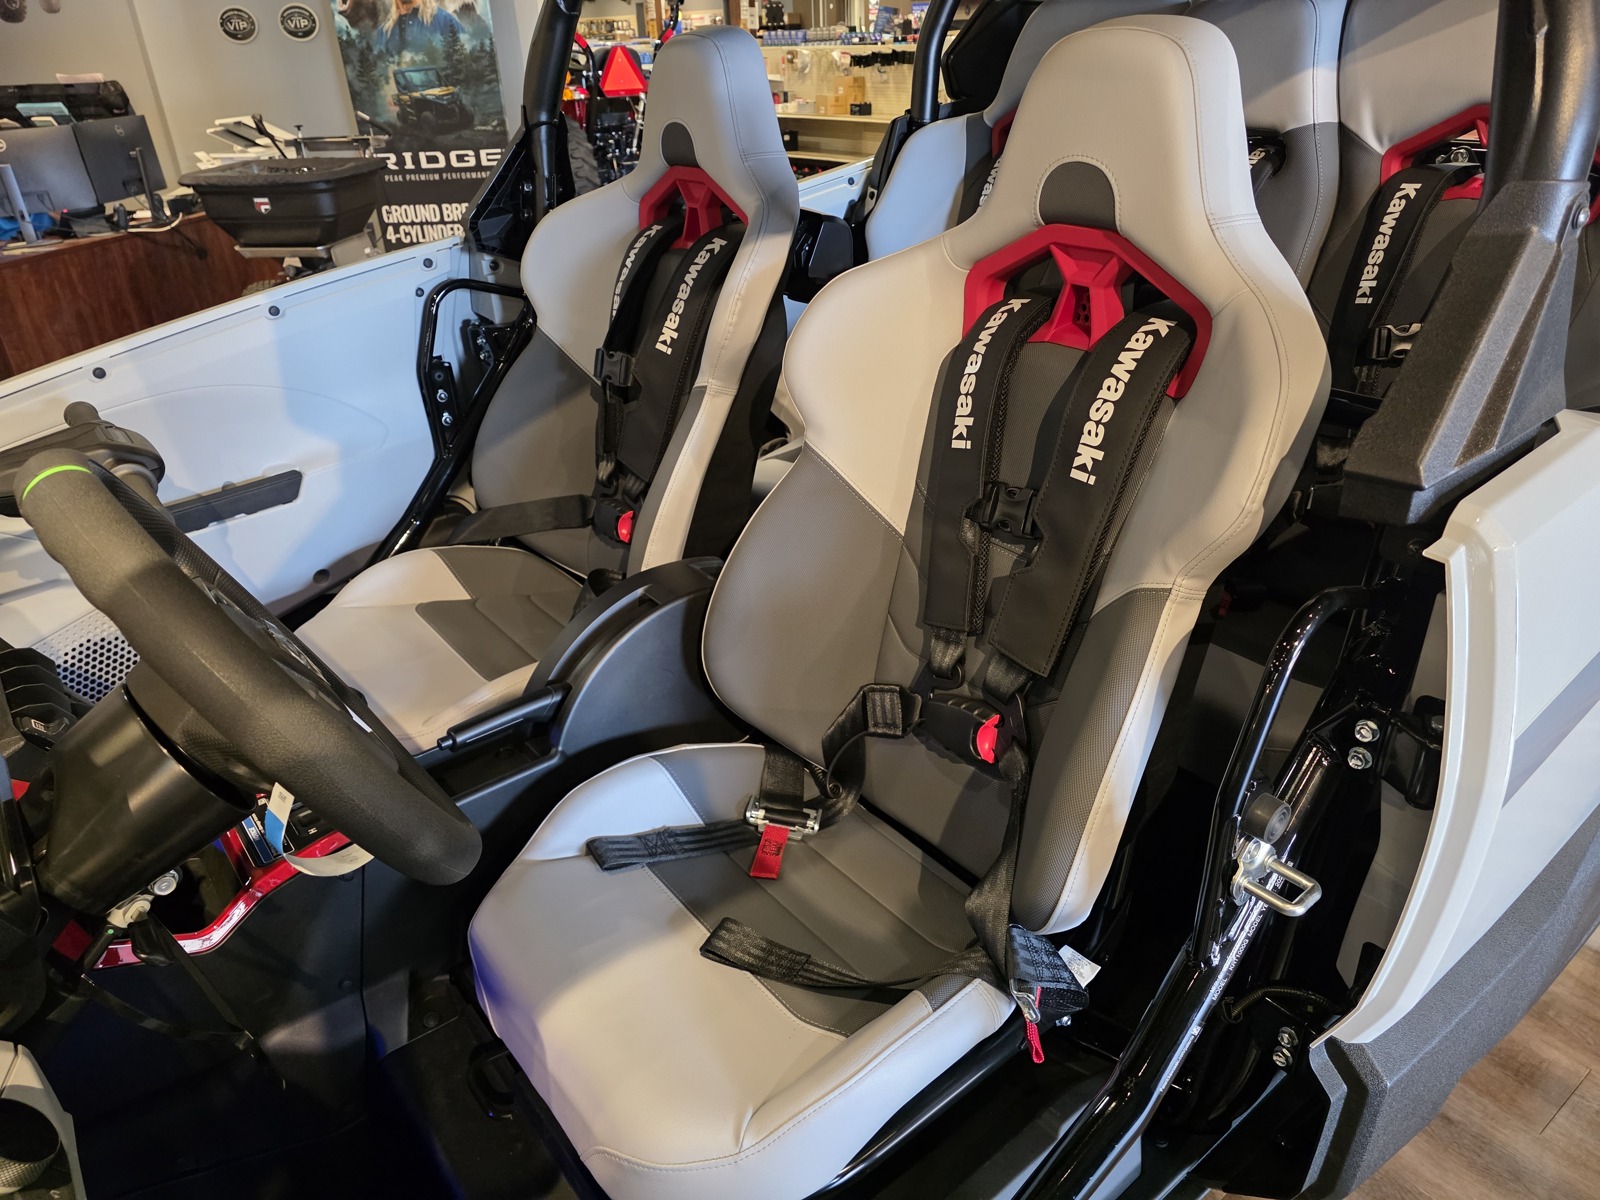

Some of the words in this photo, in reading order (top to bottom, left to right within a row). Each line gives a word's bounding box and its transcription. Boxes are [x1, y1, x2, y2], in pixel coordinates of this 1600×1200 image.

[227, 21, 248, 31] VIP
[287, 18, 309, 29] VIP
[376, 148, 502, 170] RIDGE
[384, 174, 404, 182] PEAK
[406, 172, 440, 181] PREMIUM
[381, 204, 441, 224] GROUND
[1354, 183, 1422, 304] Kawasaki
[655, 237, 728, 355] Kawasaki
[951, 298, 1032, 449] Kawasaki
[1069, 317, 1178, 486] Kawasaki
[1212, 978, 1228, 1001] MODEL
[1248, 913, 1263, 938] MODEL
